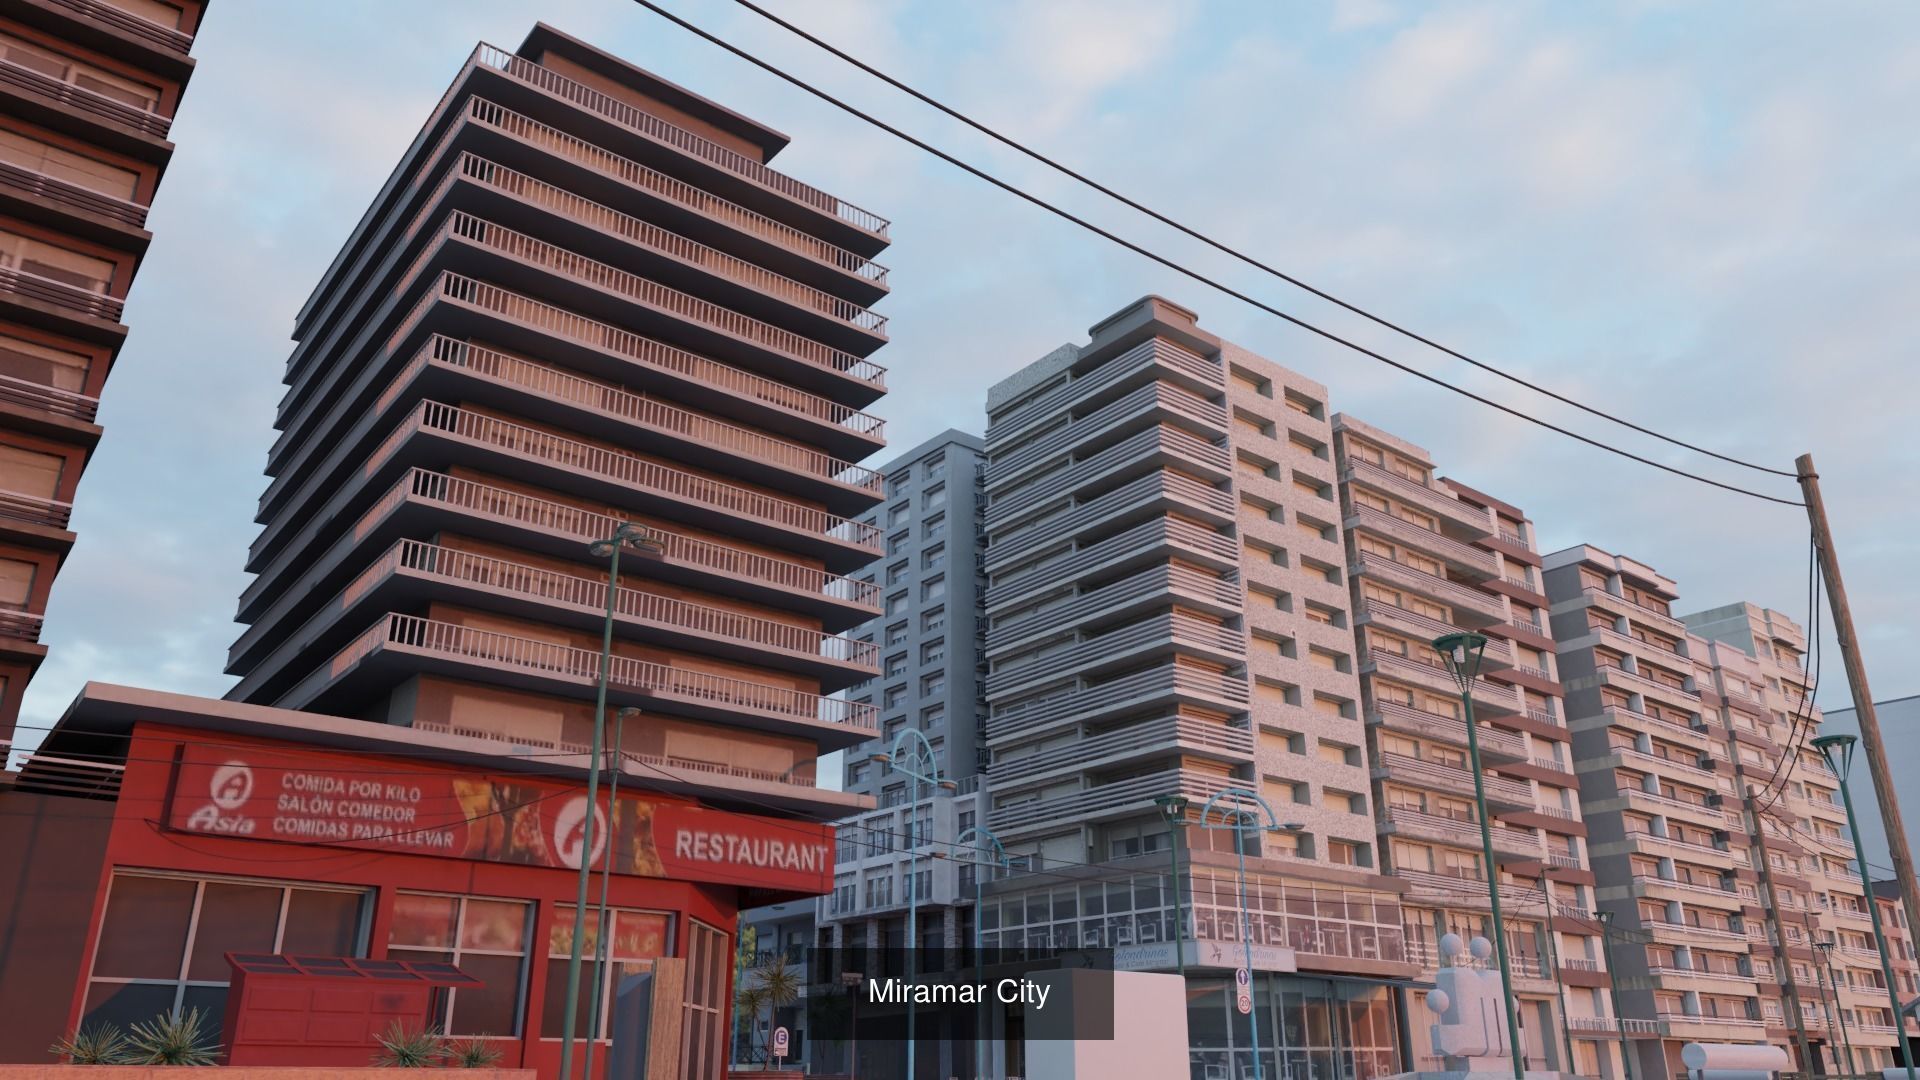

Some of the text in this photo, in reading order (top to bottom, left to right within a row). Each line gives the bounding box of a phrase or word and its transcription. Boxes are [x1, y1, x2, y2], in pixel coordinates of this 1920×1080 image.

[281, 772, 421, 803] COMIDA POR KILO
[186, 804, 256, 835] Asia
[277, 793, 417, 823] SALÓN COMEDOR
[272, 816, 455, 848] COMIDAS PARA LLEVAR
[675, 829, 829, 873] RESTAURANT
[777, 1031, 785, 1043] E
